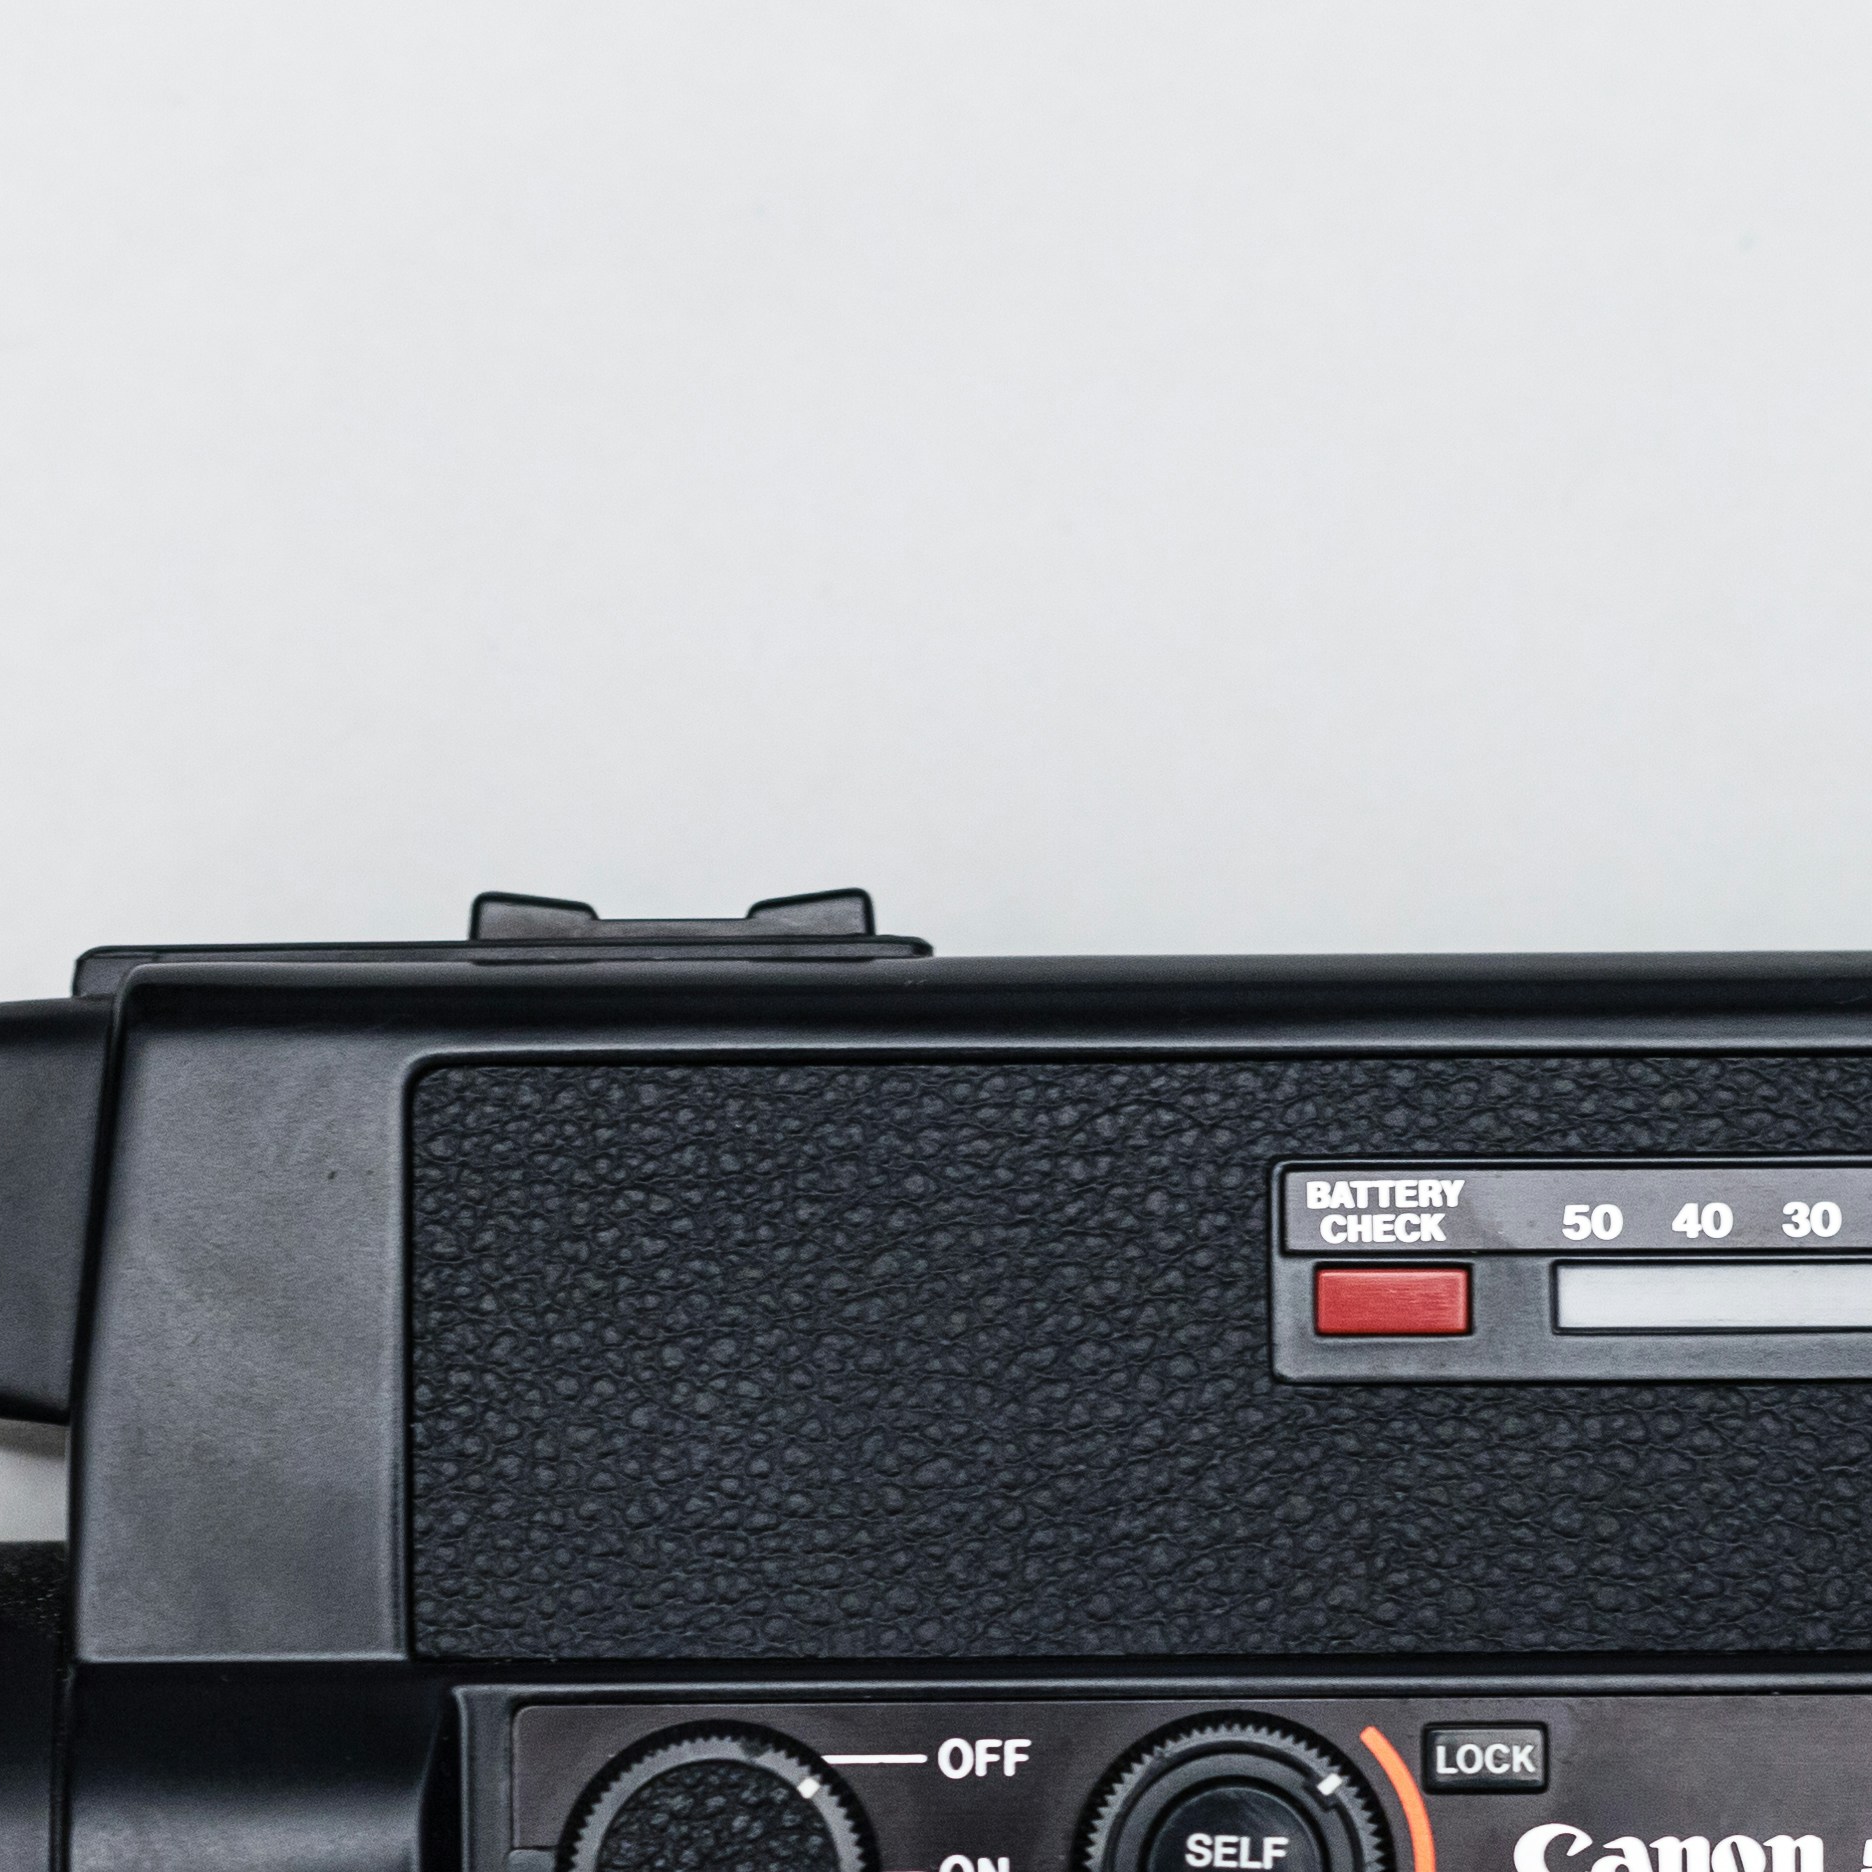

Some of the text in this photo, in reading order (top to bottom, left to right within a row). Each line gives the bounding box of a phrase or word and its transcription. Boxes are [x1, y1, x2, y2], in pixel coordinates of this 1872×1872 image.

[1305, 1178, 1466, 1210] BATTERY
[1319, 1212, 1448, 1245] CHECK
[1561, 1203, 1625, 1242] 50
[1671, 1202, 1735, 1240] 40
[1781, 1201, 1844, 1239] 30
[936, 1737, 1033, 1780] OFF
[1435, 1742, 1537, 1775] LOCK
[1184, 1832, 1290, 1870] SELF
